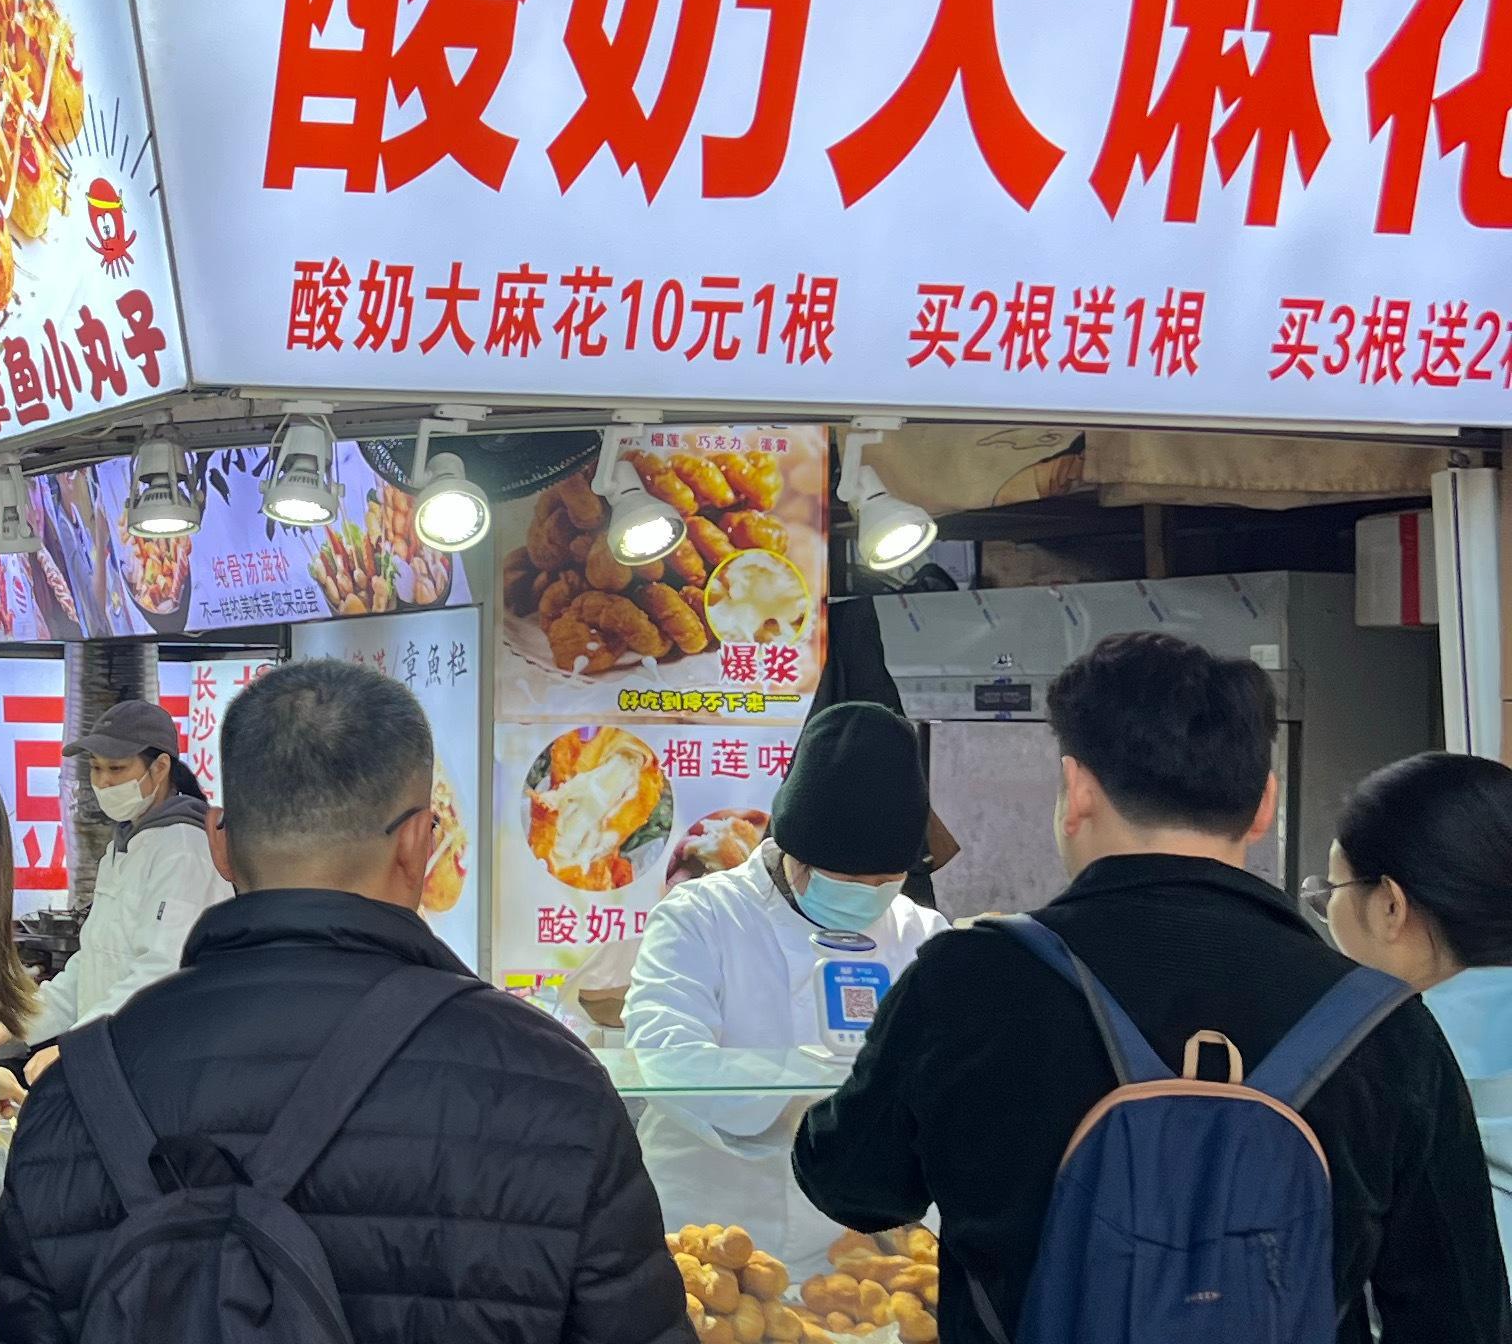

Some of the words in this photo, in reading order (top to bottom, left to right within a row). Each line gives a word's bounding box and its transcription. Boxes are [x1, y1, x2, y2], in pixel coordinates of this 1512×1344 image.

[286, 256, 838, 365] 酸奶大麻花10元1根
[906, 280, 1207, 378] 买2根送1根
[1268, 296, 1512, 390] 买3根送2
[212, 546, 290, 590] 纯骨汤滋补
[199, 586, 320, 625] 不一样的美味等您来品尝
[719, 644, 800, 684] 爆浆
[537, 906, 649, 945] 酸奶
